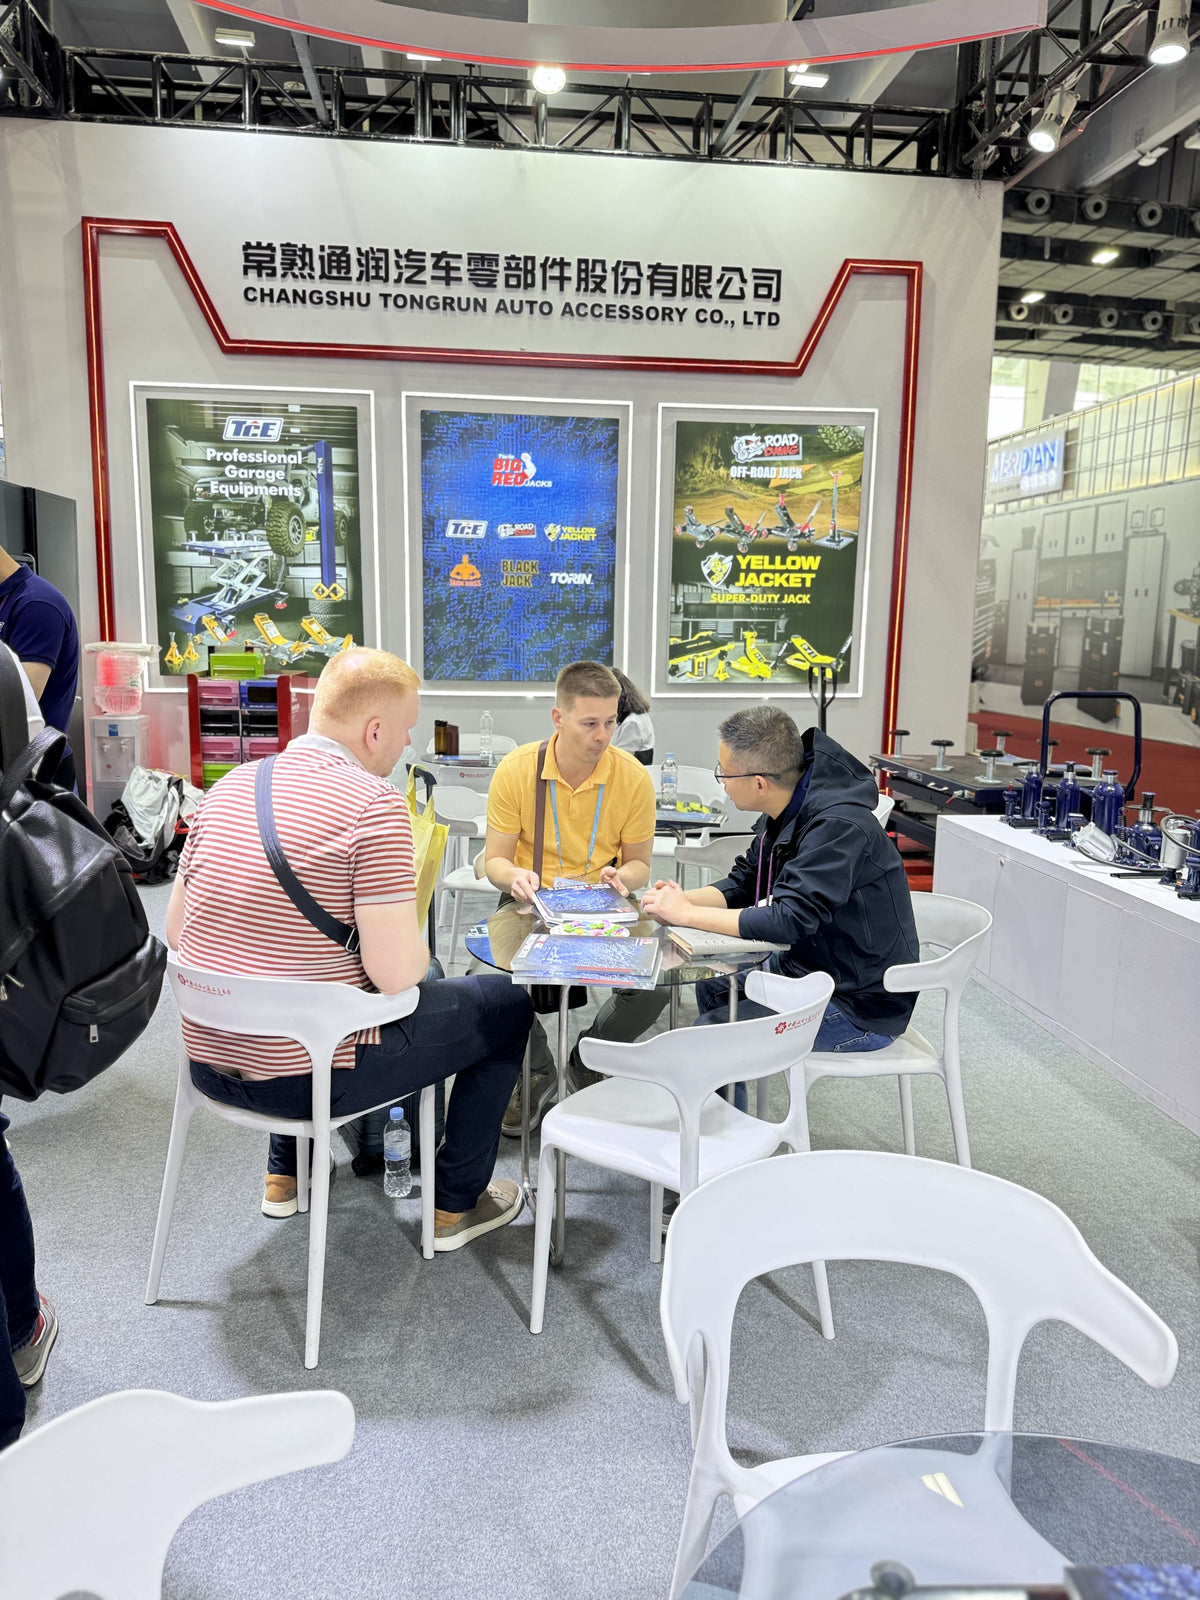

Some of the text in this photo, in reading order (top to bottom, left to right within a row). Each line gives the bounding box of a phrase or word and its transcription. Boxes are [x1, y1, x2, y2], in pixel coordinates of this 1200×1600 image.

[242, 241, 782, 303] 常熟通润汽车零部件股份有限公司
[243, 286, 780, 328] CHANGSHU TONGRUN AUTO ACCESSORY CO., LTD
[764, 433, 799, 447] ROAD
[206, 448, 302, 464] Professional
[764, 444, 799, 457] DAWG
[492, 458, 523, 473] BIG
[730, 465, 803, 479] OFF-ROAD JACK
[224, 465, 286, 483] Garage
[491, 473, 527, 487] RED
[210, 481, 302, 498] Equipments
[524, 480, 553, 488] JACKS
[559, 533, 597, 541] JACKET
[561, 526, 597, 534] YELLOW
[501, 560, 539, 573] BLACK
[735, 554, 822, 570] YELLOW
[502, 574, 532, 588] JACK
[550, 572, 592, 585] TORIN
[734, 572, 816, 588] JACKET
[710, 593, 811, 604] SUPER-DUTY JACK
